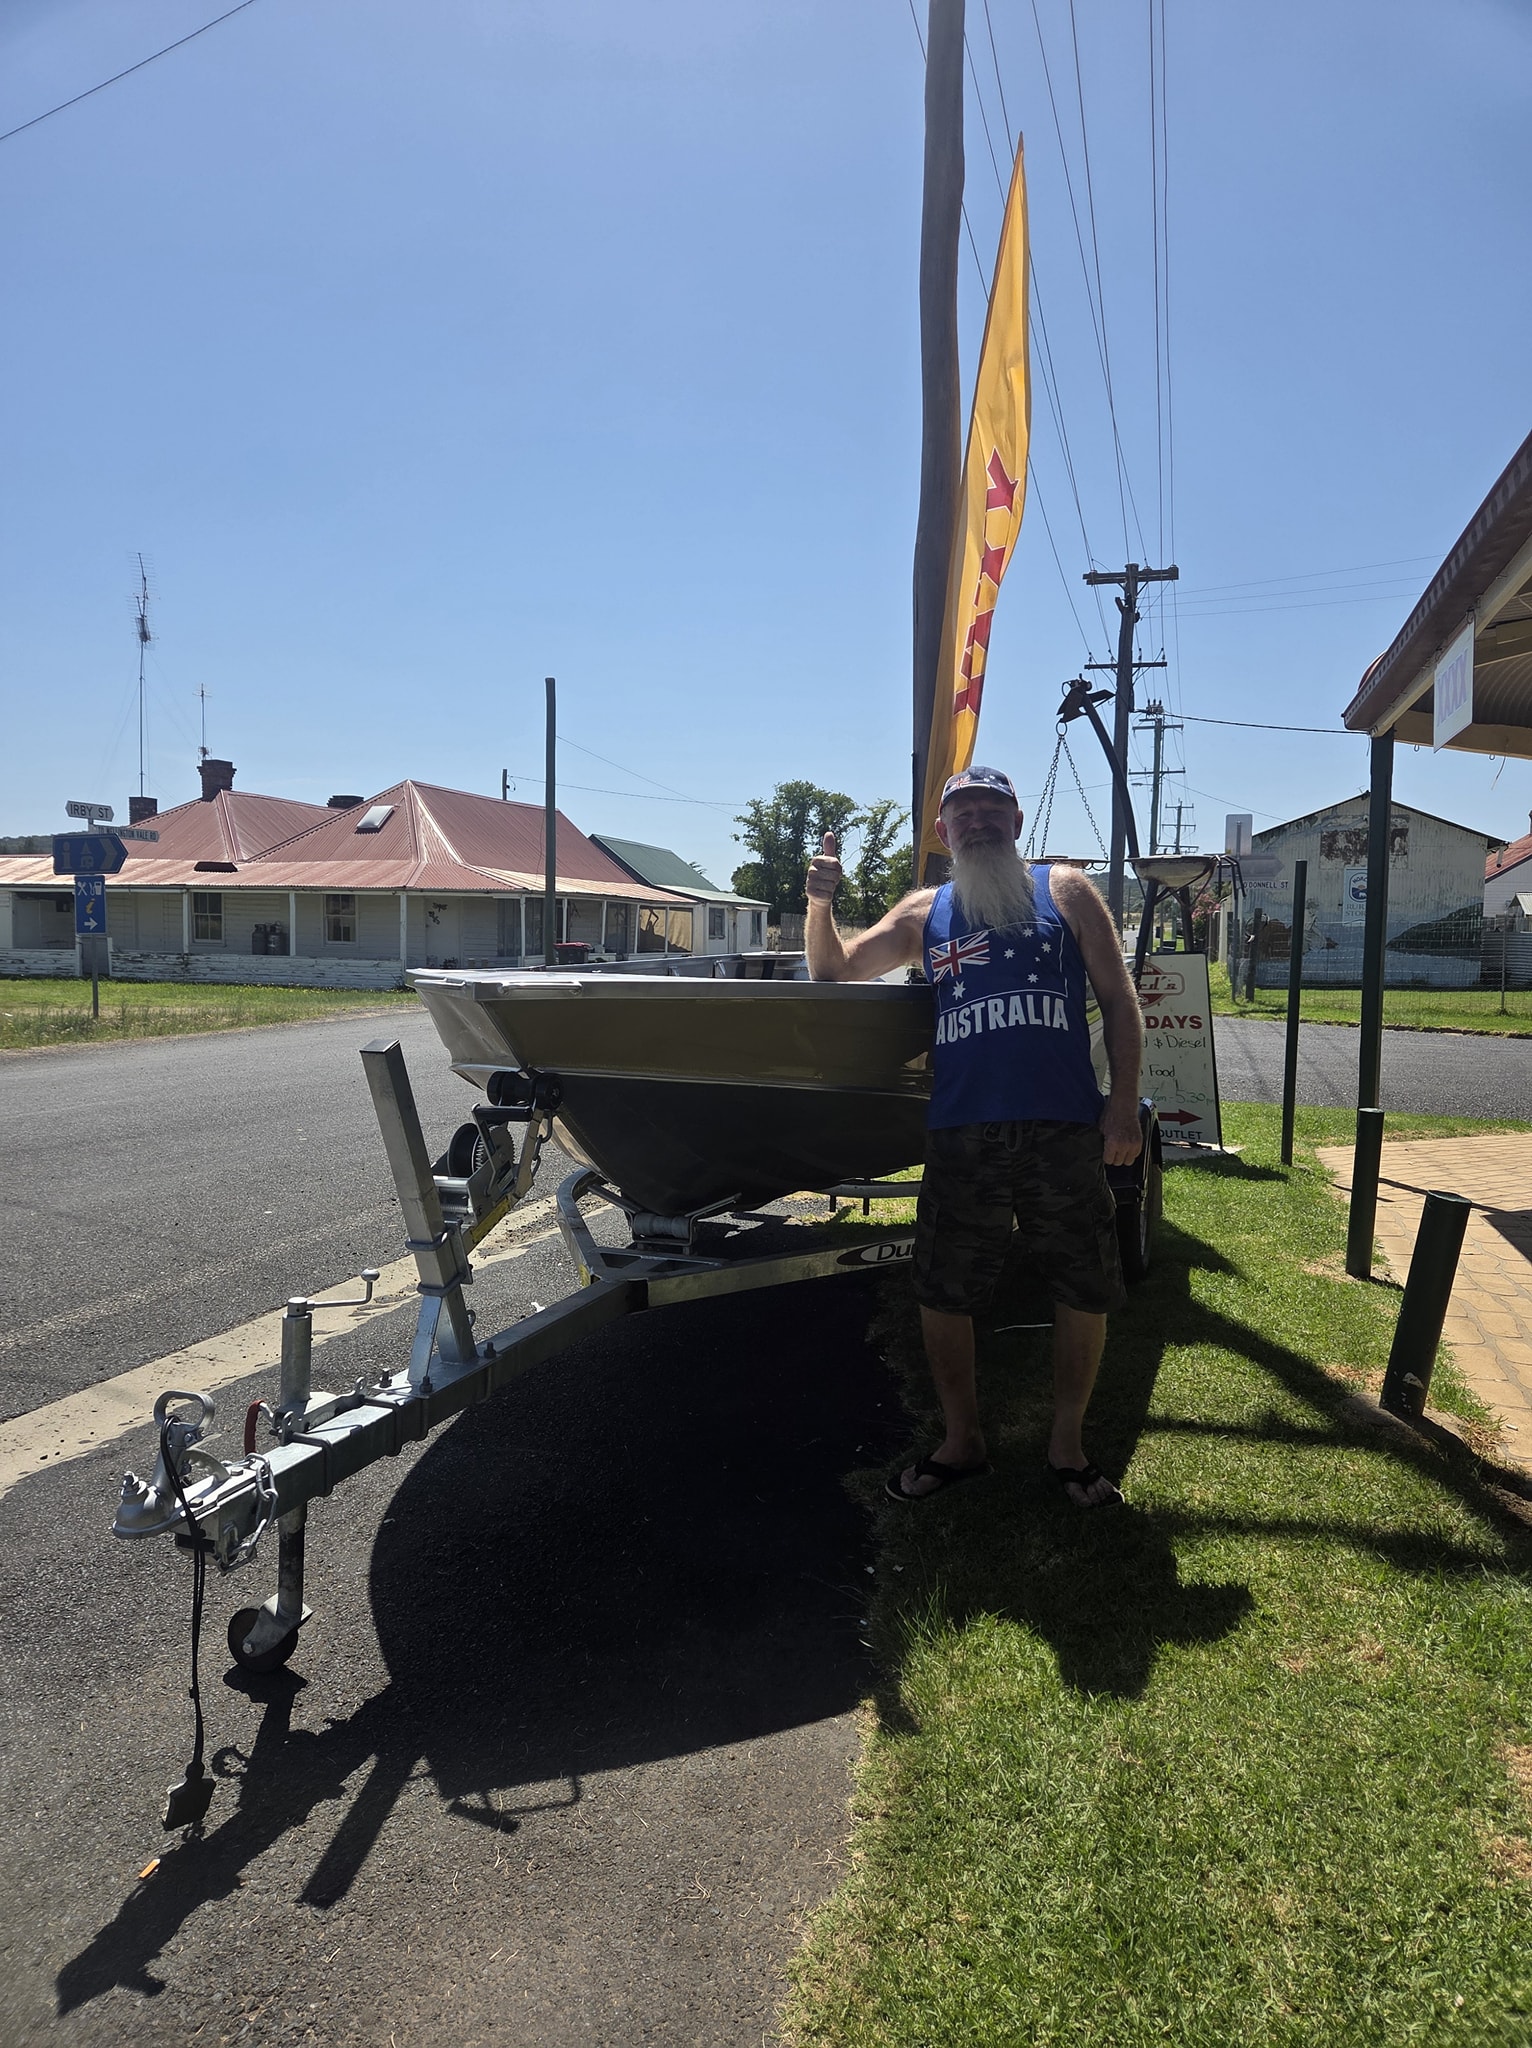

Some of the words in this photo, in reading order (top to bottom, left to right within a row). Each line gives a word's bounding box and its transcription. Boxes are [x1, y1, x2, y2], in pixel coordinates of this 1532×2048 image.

[70, 803, 93, 817] IRBY
[98, 807, 109, 819] ST
[1280, 881, 1289, 889] ST
[936, 994, 1069, 1046] AUSTRALIA
[1145, 1015, 1203, 1030] DAYS
[1166, 1034, 1206, 1048] Diesel
[1149, 1064, 1176, 1077] Food
